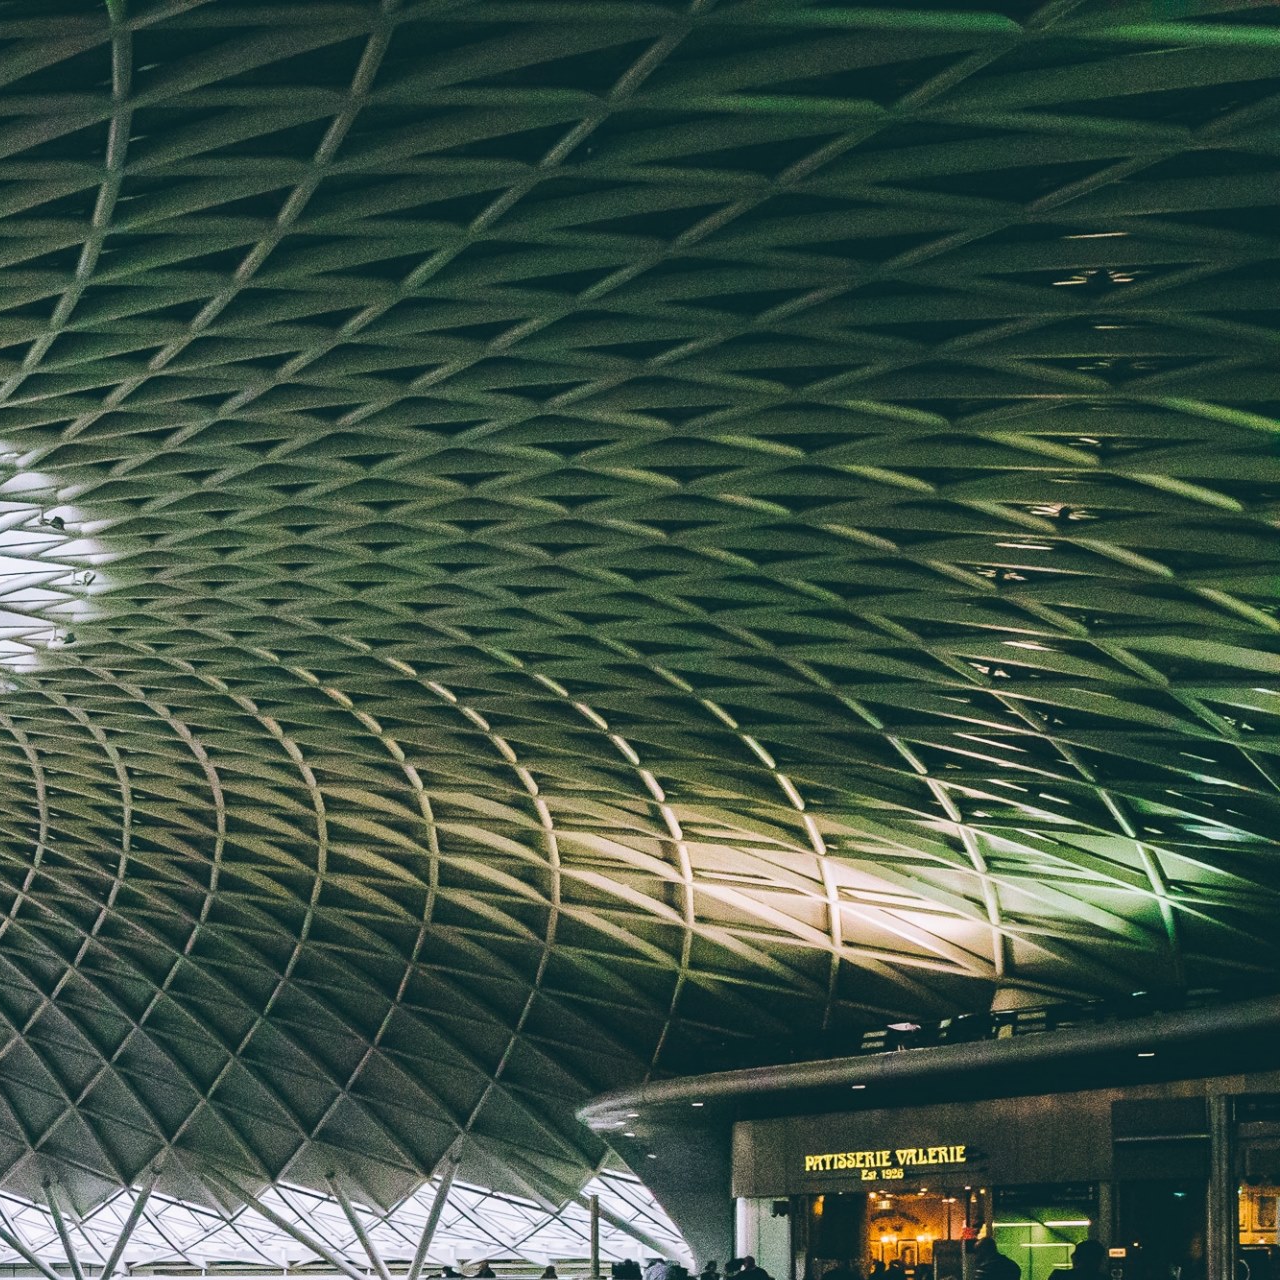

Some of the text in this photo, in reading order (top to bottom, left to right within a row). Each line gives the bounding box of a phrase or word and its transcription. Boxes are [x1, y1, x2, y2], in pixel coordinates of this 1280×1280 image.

[805, 1145, 967, 1171] PATISSERIE VALERIE
[881, 1168, 904, 1180] 1926
